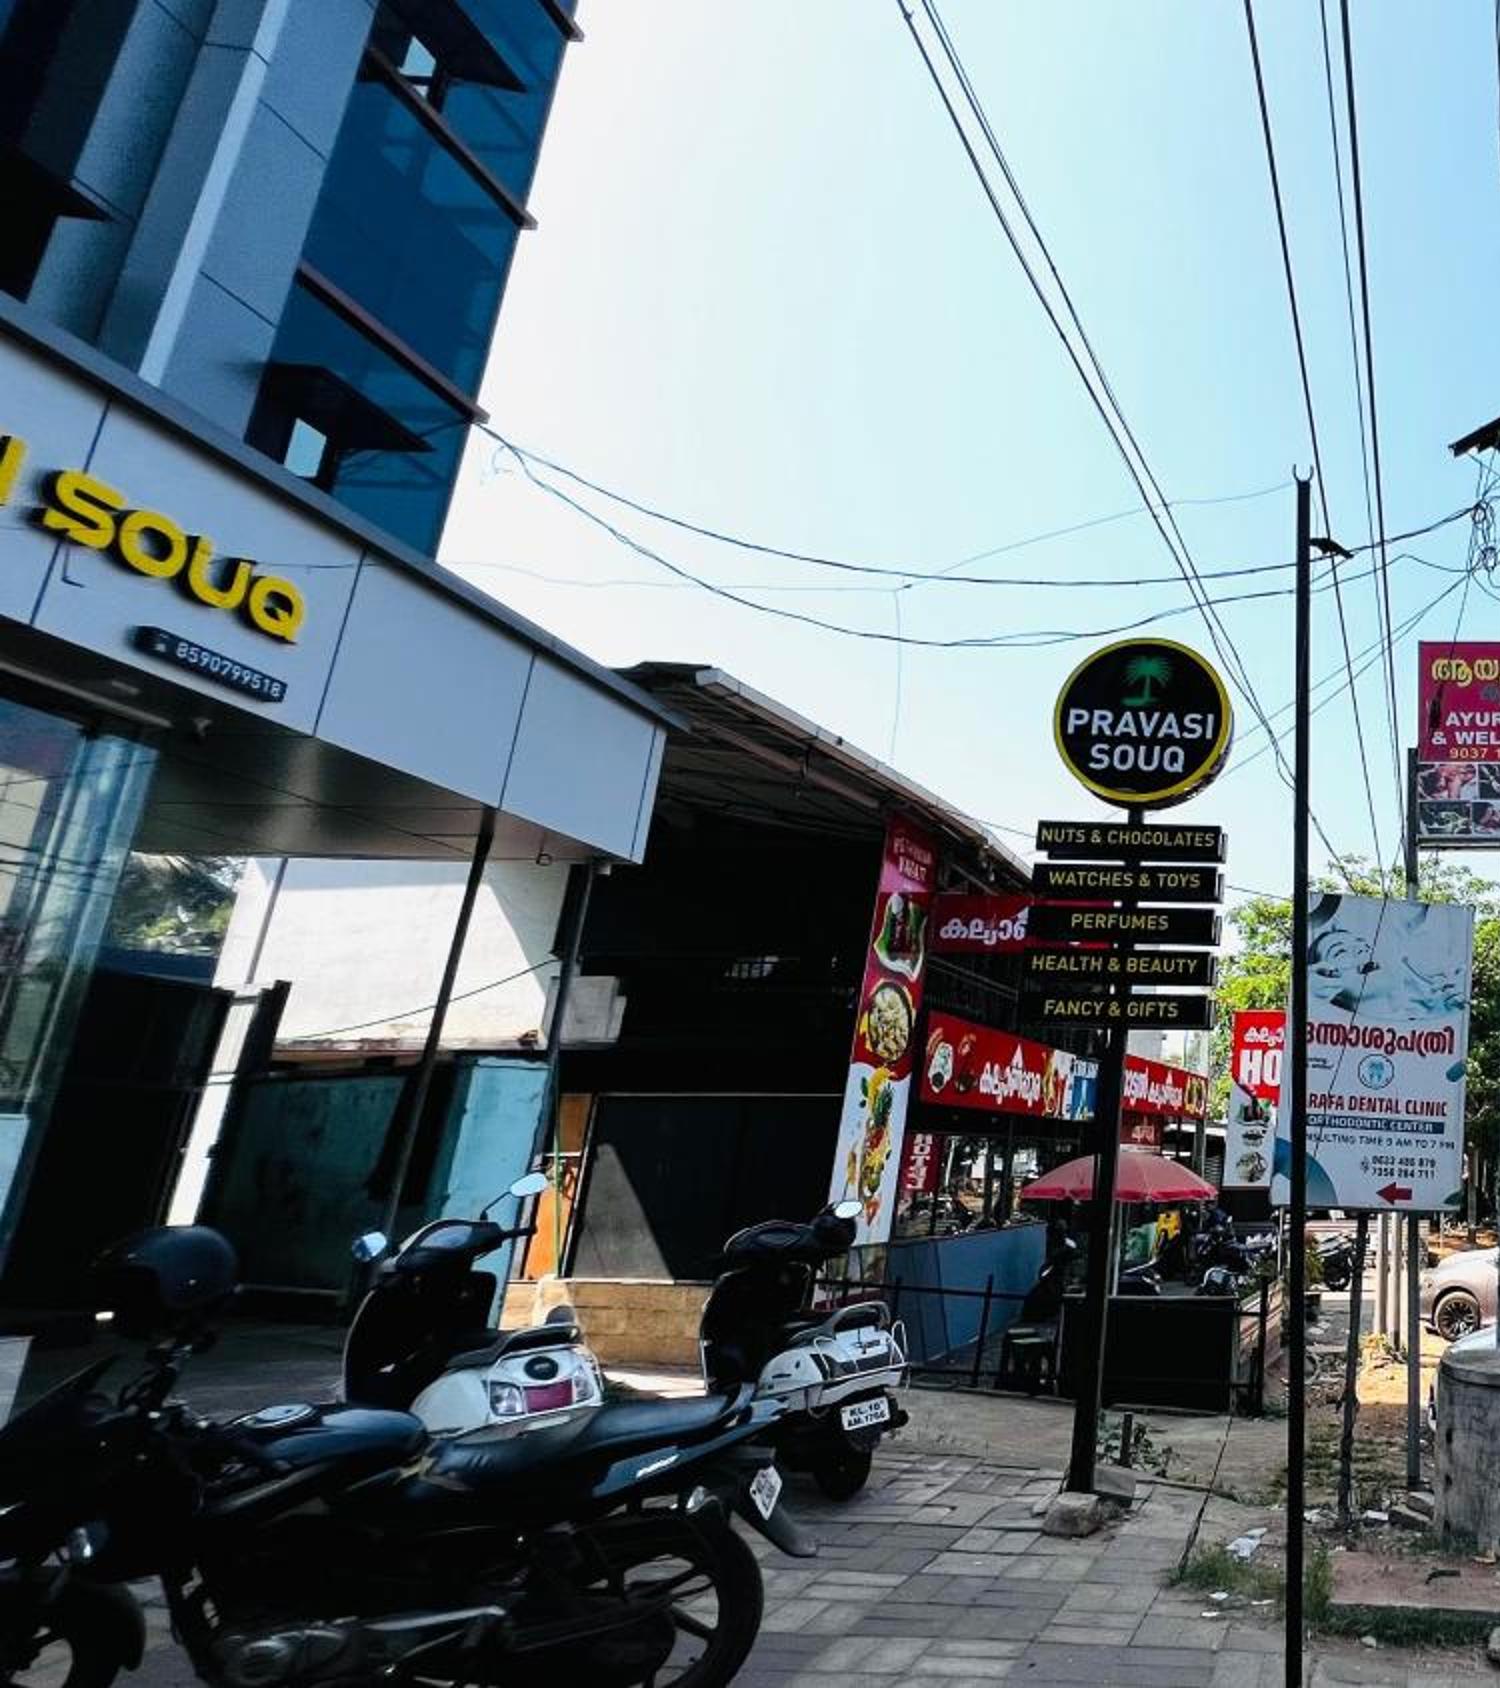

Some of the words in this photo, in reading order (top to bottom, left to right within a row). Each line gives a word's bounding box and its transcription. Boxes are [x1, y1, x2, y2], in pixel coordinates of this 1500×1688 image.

[41, 469, 305, 643] SOUQ
[175, 643, 282, 698] 8590799518
[1067, 708, 1214, 741] PRAVASI
[1431, 731, 1447, 745] &
[1089, 744, 1185, 774] SOUQ
[1449, 748, 1487, 759] 9037
[1041, 829, 1085, 844] NUTS
[1090, 830, 1101, 844] &
[1107, 830, 1216, 847] CHOCOLATES
[1049, 871, 1134, 887] WATCHES
[1139, 873, 1151, 887] &
[1157, 873, 1200, 888] TOYS
[1070, 913, 1169, 930] PERFUMES
[1031, 955, 1103, 972] HEALTH
[1108, 956, 1120, 972] &
[1126, 957, 1198, 975] BEAUTY
[1043, 999, 1104, 1016] FANCY
[1108, 1001, 1120, 1016] &
[1127, 1001, 1179, 1018] GIFTS
[1239, 1049, 1283, 1087] HO
[1308, 1093, 1345, 1110] RAFA
[1348, 1095, 1400, 1115] DENTAL
[1406, 1099, 1447, 1117] CLINIC
[1306, 1133, 1356, 1145] NSULTING
